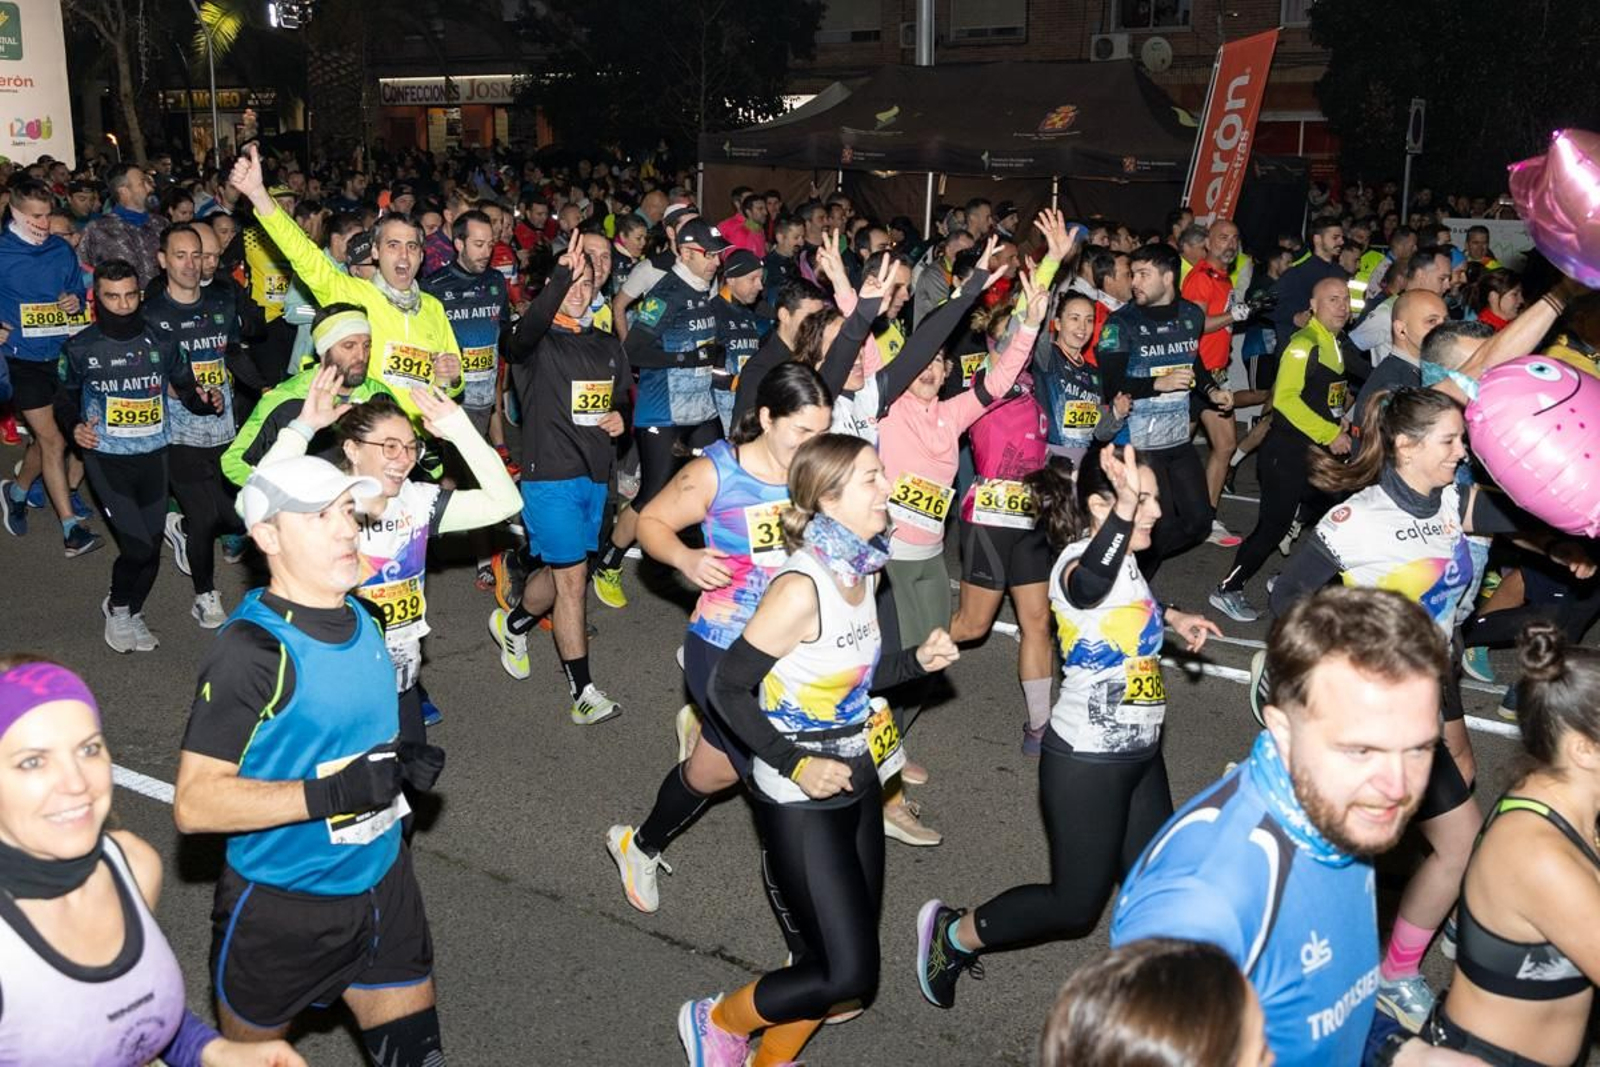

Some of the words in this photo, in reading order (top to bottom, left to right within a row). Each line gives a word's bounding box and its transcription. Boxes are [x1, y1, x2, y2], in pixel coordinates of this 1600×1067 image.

[26, 311, 65, 325] 3808
[1140, 344, 1165, 357] SAN
[389, 355, 432, 378] 3913
[462, 355, 493, 369] 3498
[91, 379, 118, 394] SAN
[112, 408, 160, 425] 3956
[1068, 411, 1098, 424] 3476
[897, 485, 944, 515] 3216
[1130, 675, 1165, 698] 338
